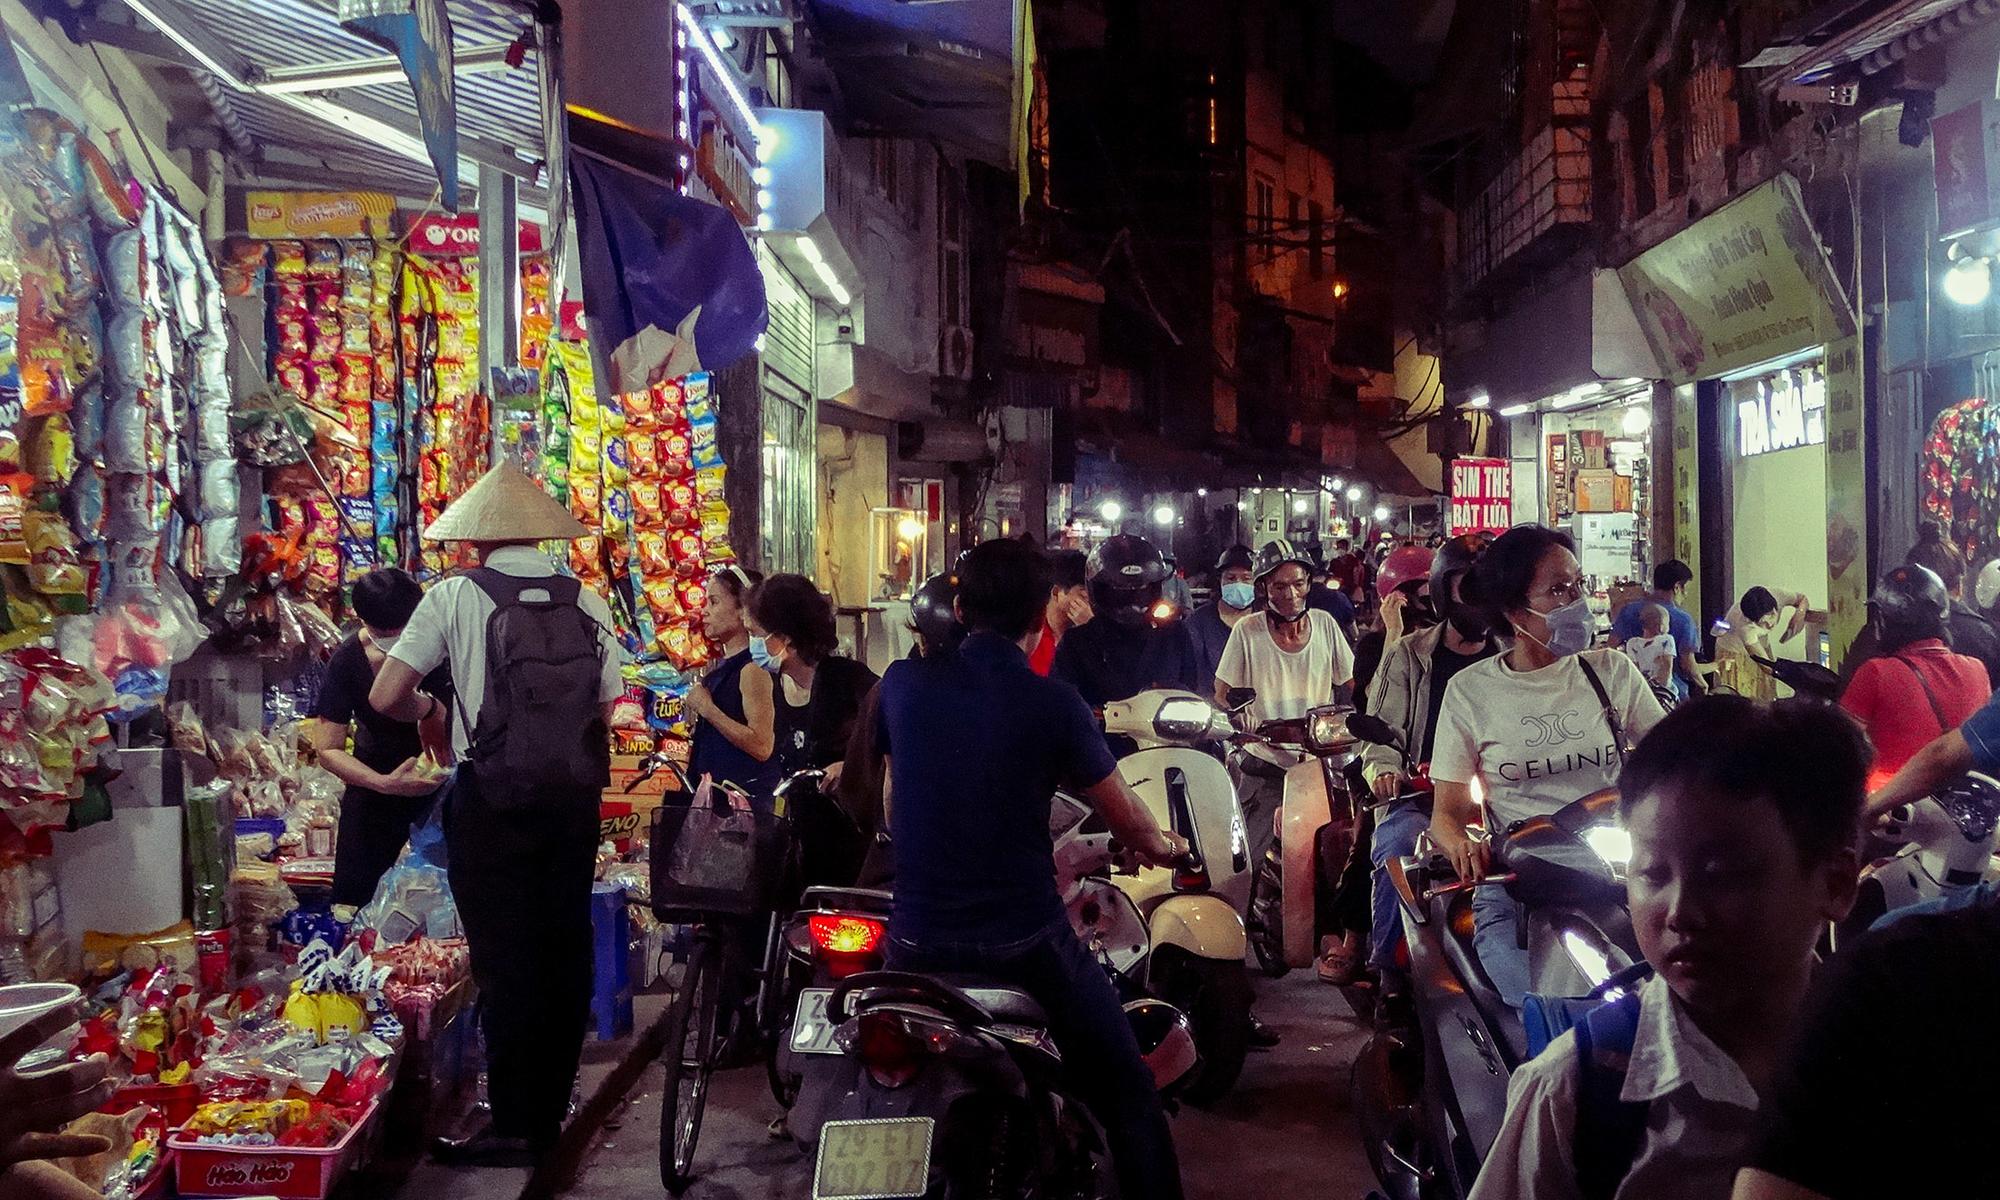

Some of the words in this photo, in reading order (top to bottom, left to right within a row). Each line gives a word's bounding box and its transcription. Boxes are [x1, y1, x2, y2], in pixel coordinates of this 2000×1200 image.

[451, 227, 480, 243] OR
[1453, 466, 1480, 498] SIM
[1498, 744, 1616, 782] CELINE
[600, 813, 640, 835] ENO
